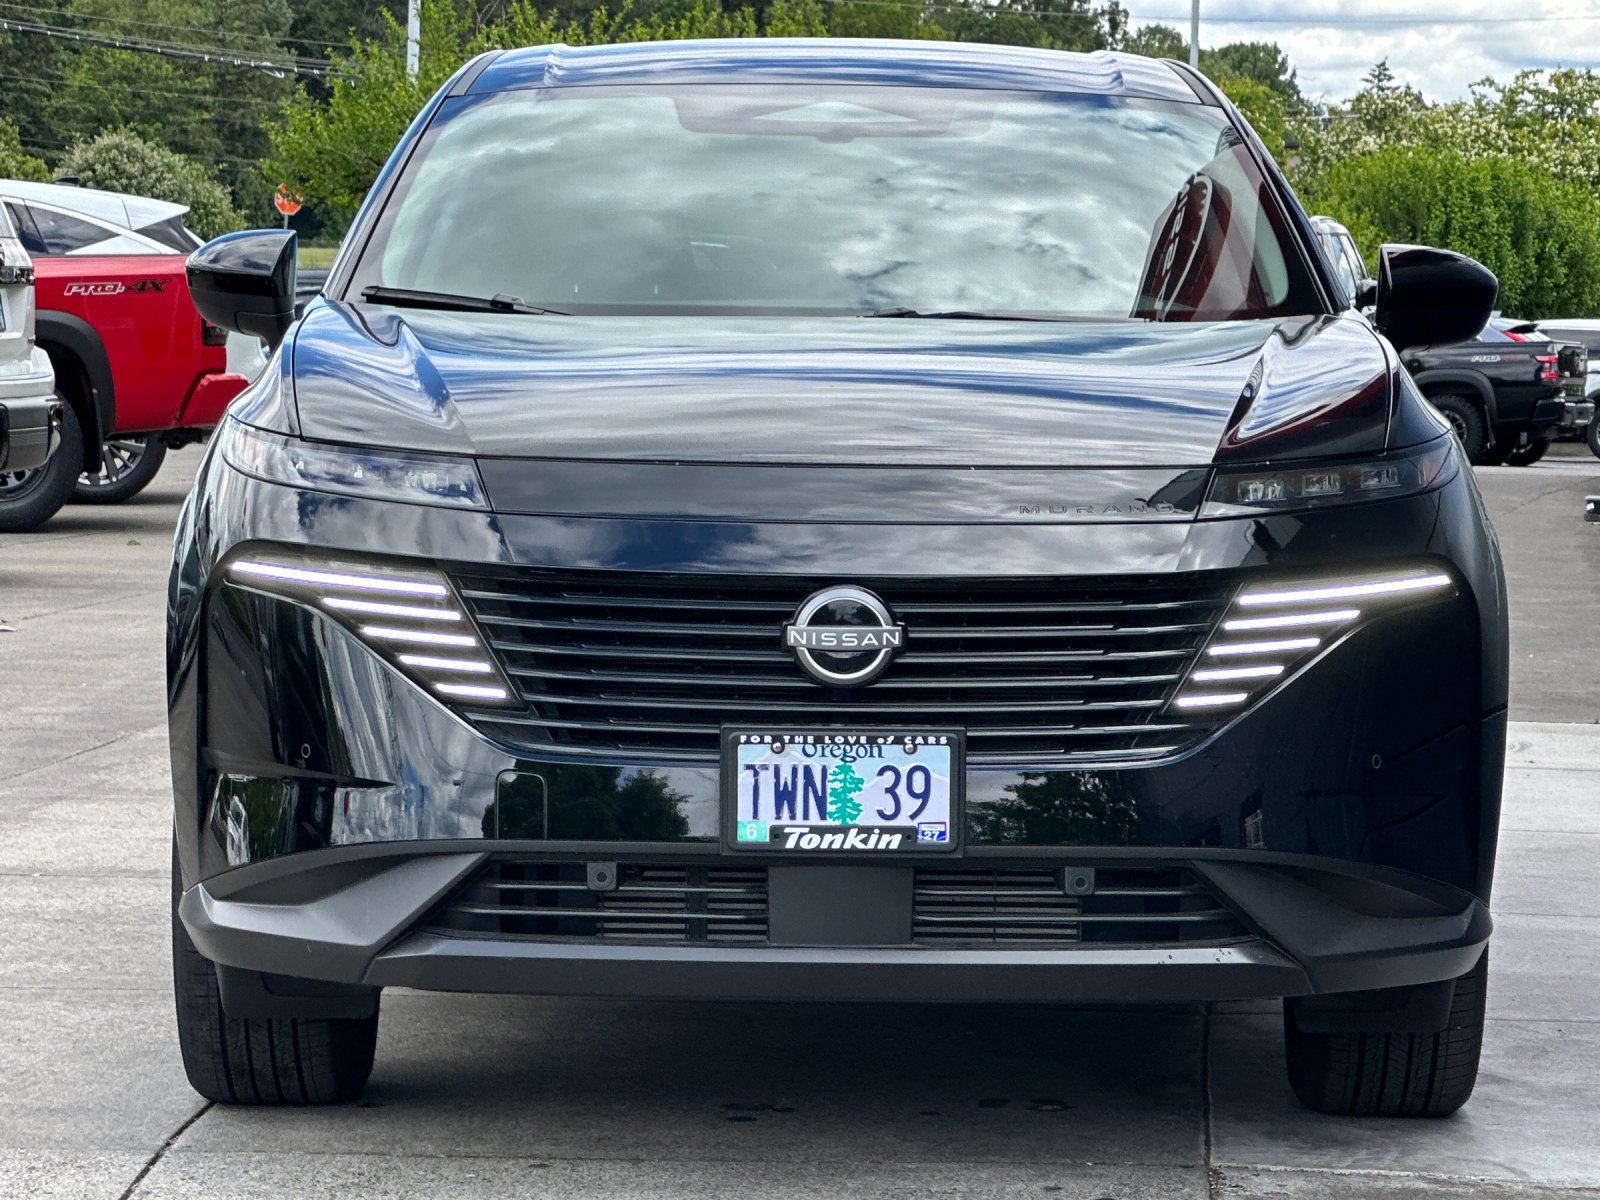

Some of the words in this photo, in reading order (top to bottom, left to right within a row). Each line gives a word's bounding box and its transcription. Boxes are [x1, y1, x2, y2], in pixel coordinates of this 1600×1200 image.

[1019, 504, 1174, 514] MURANO
[790, 630, 900, 646] NISSAN
[740, 735, 772, 743] FOR
[783, 735, 814, 743] THE
[824, 735, 867, 744] LOVE
[877, 735, 895, 744] of
[904, 736, 948, 744] CARS
[801, 744, 885, 763] Oregon
[744, 763, 828, 820] TWN
[876, 764, 932, 821] 39
[746, 824, 757, 839] 6
[783, 828, 902, 849] Tonkin
[923, 831, 940, 840] 27
